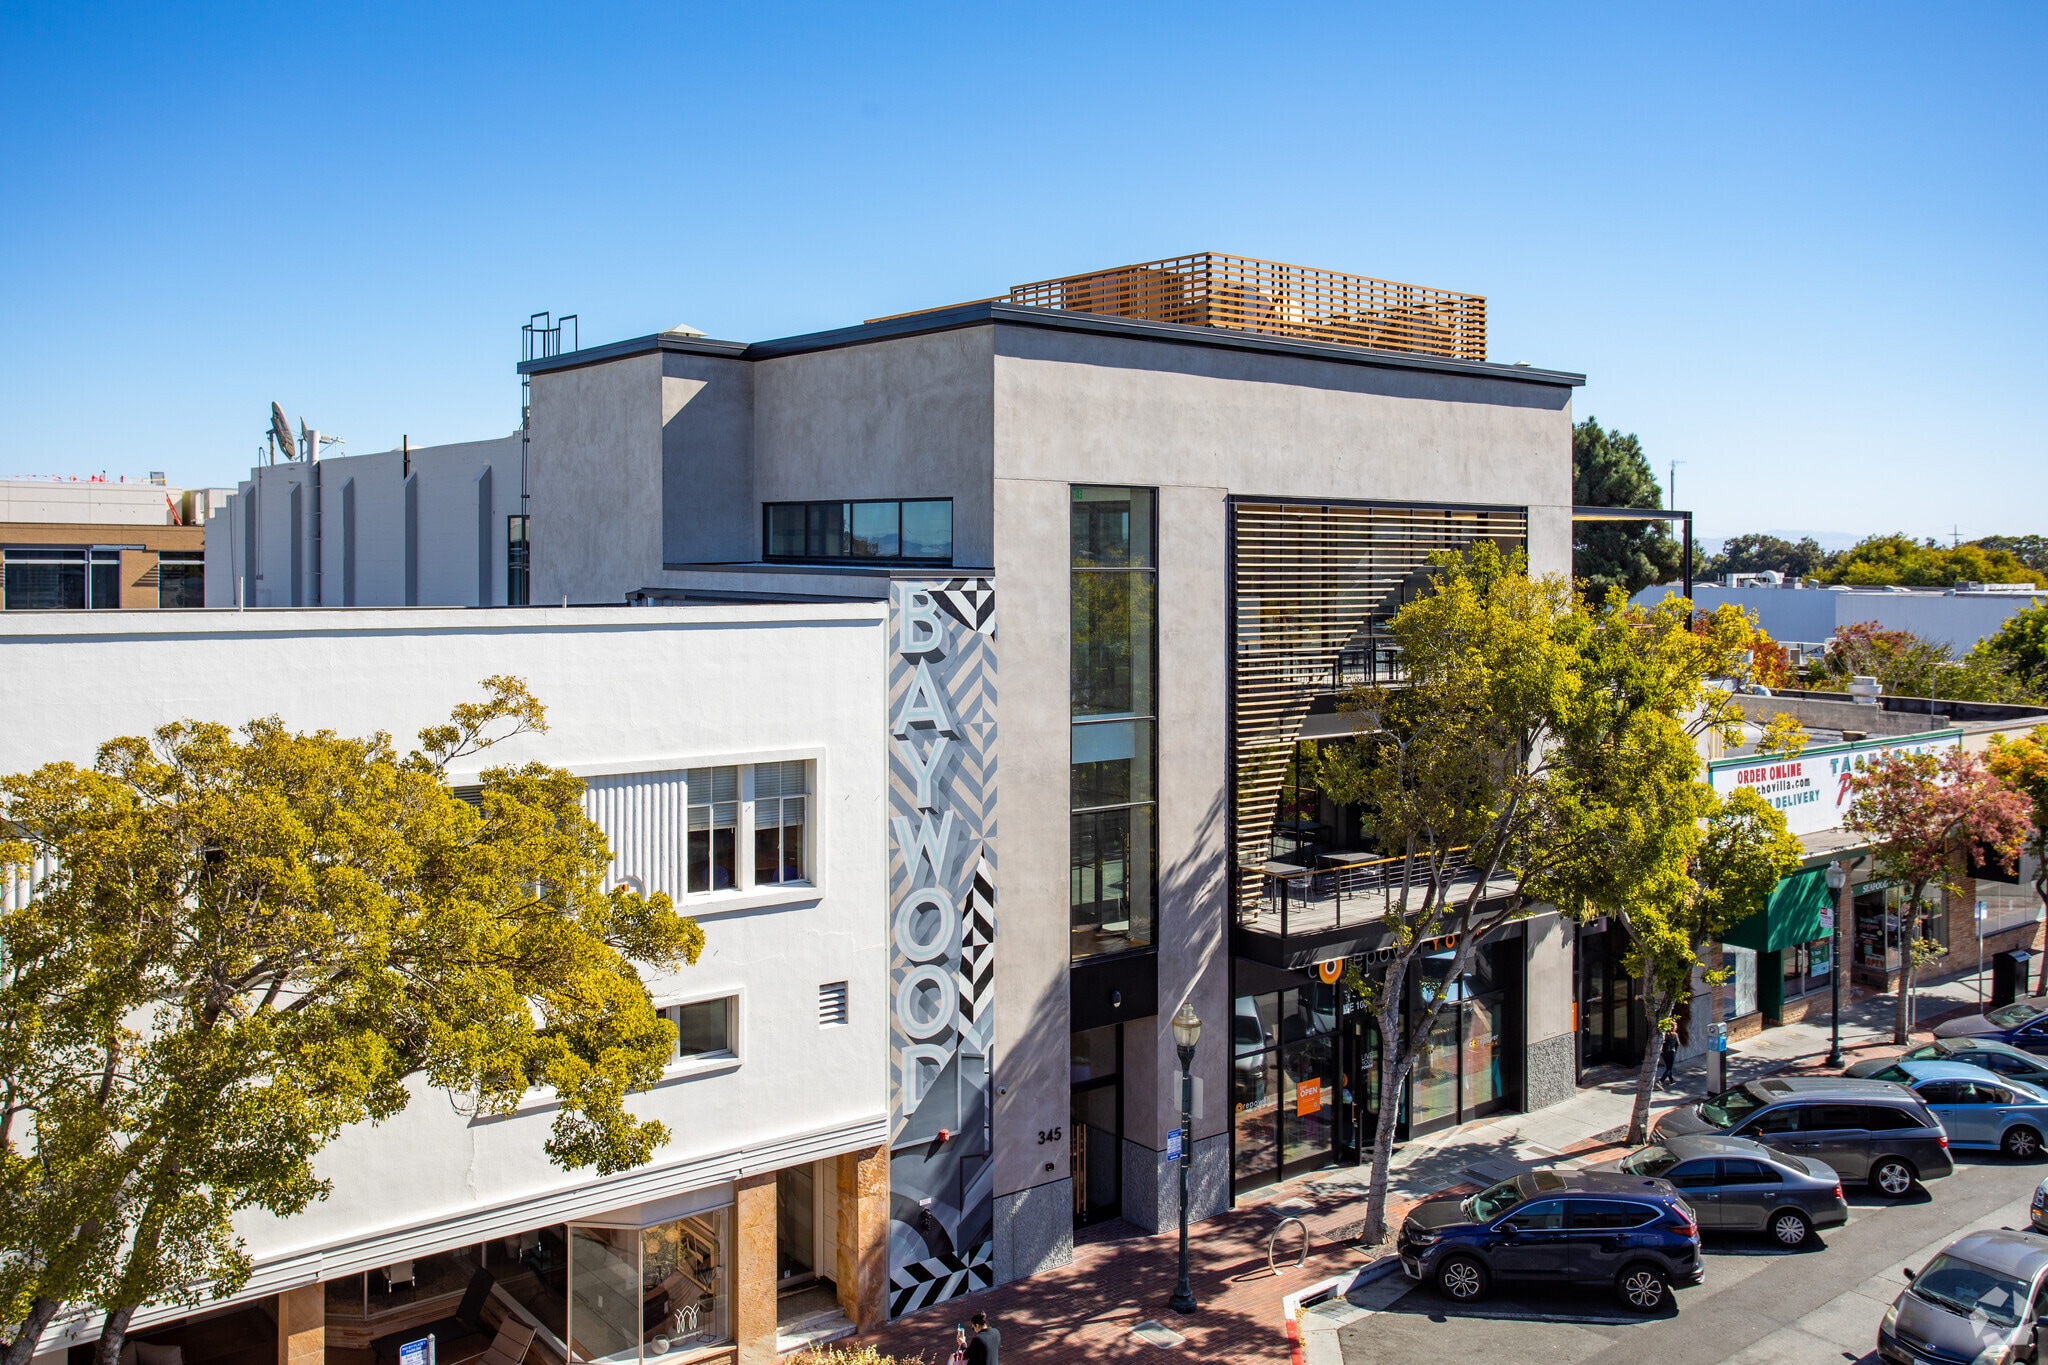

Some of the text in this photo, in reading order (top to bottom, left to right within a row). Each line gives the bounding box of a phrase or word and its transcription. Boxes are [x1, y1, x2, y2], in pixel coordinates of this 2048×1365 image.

[1737, 762, 1802, 785] ORDER ONLINE
[1775, 788, 1821, 809] DELIVERY
[893, 581, 956, 1118] BAYWOOD
[1866, 958, 1885, 968] OPEN
[1300, 1087, 1318, 1098] OPEN
[1038, 1127, 1062, 1145] 345
